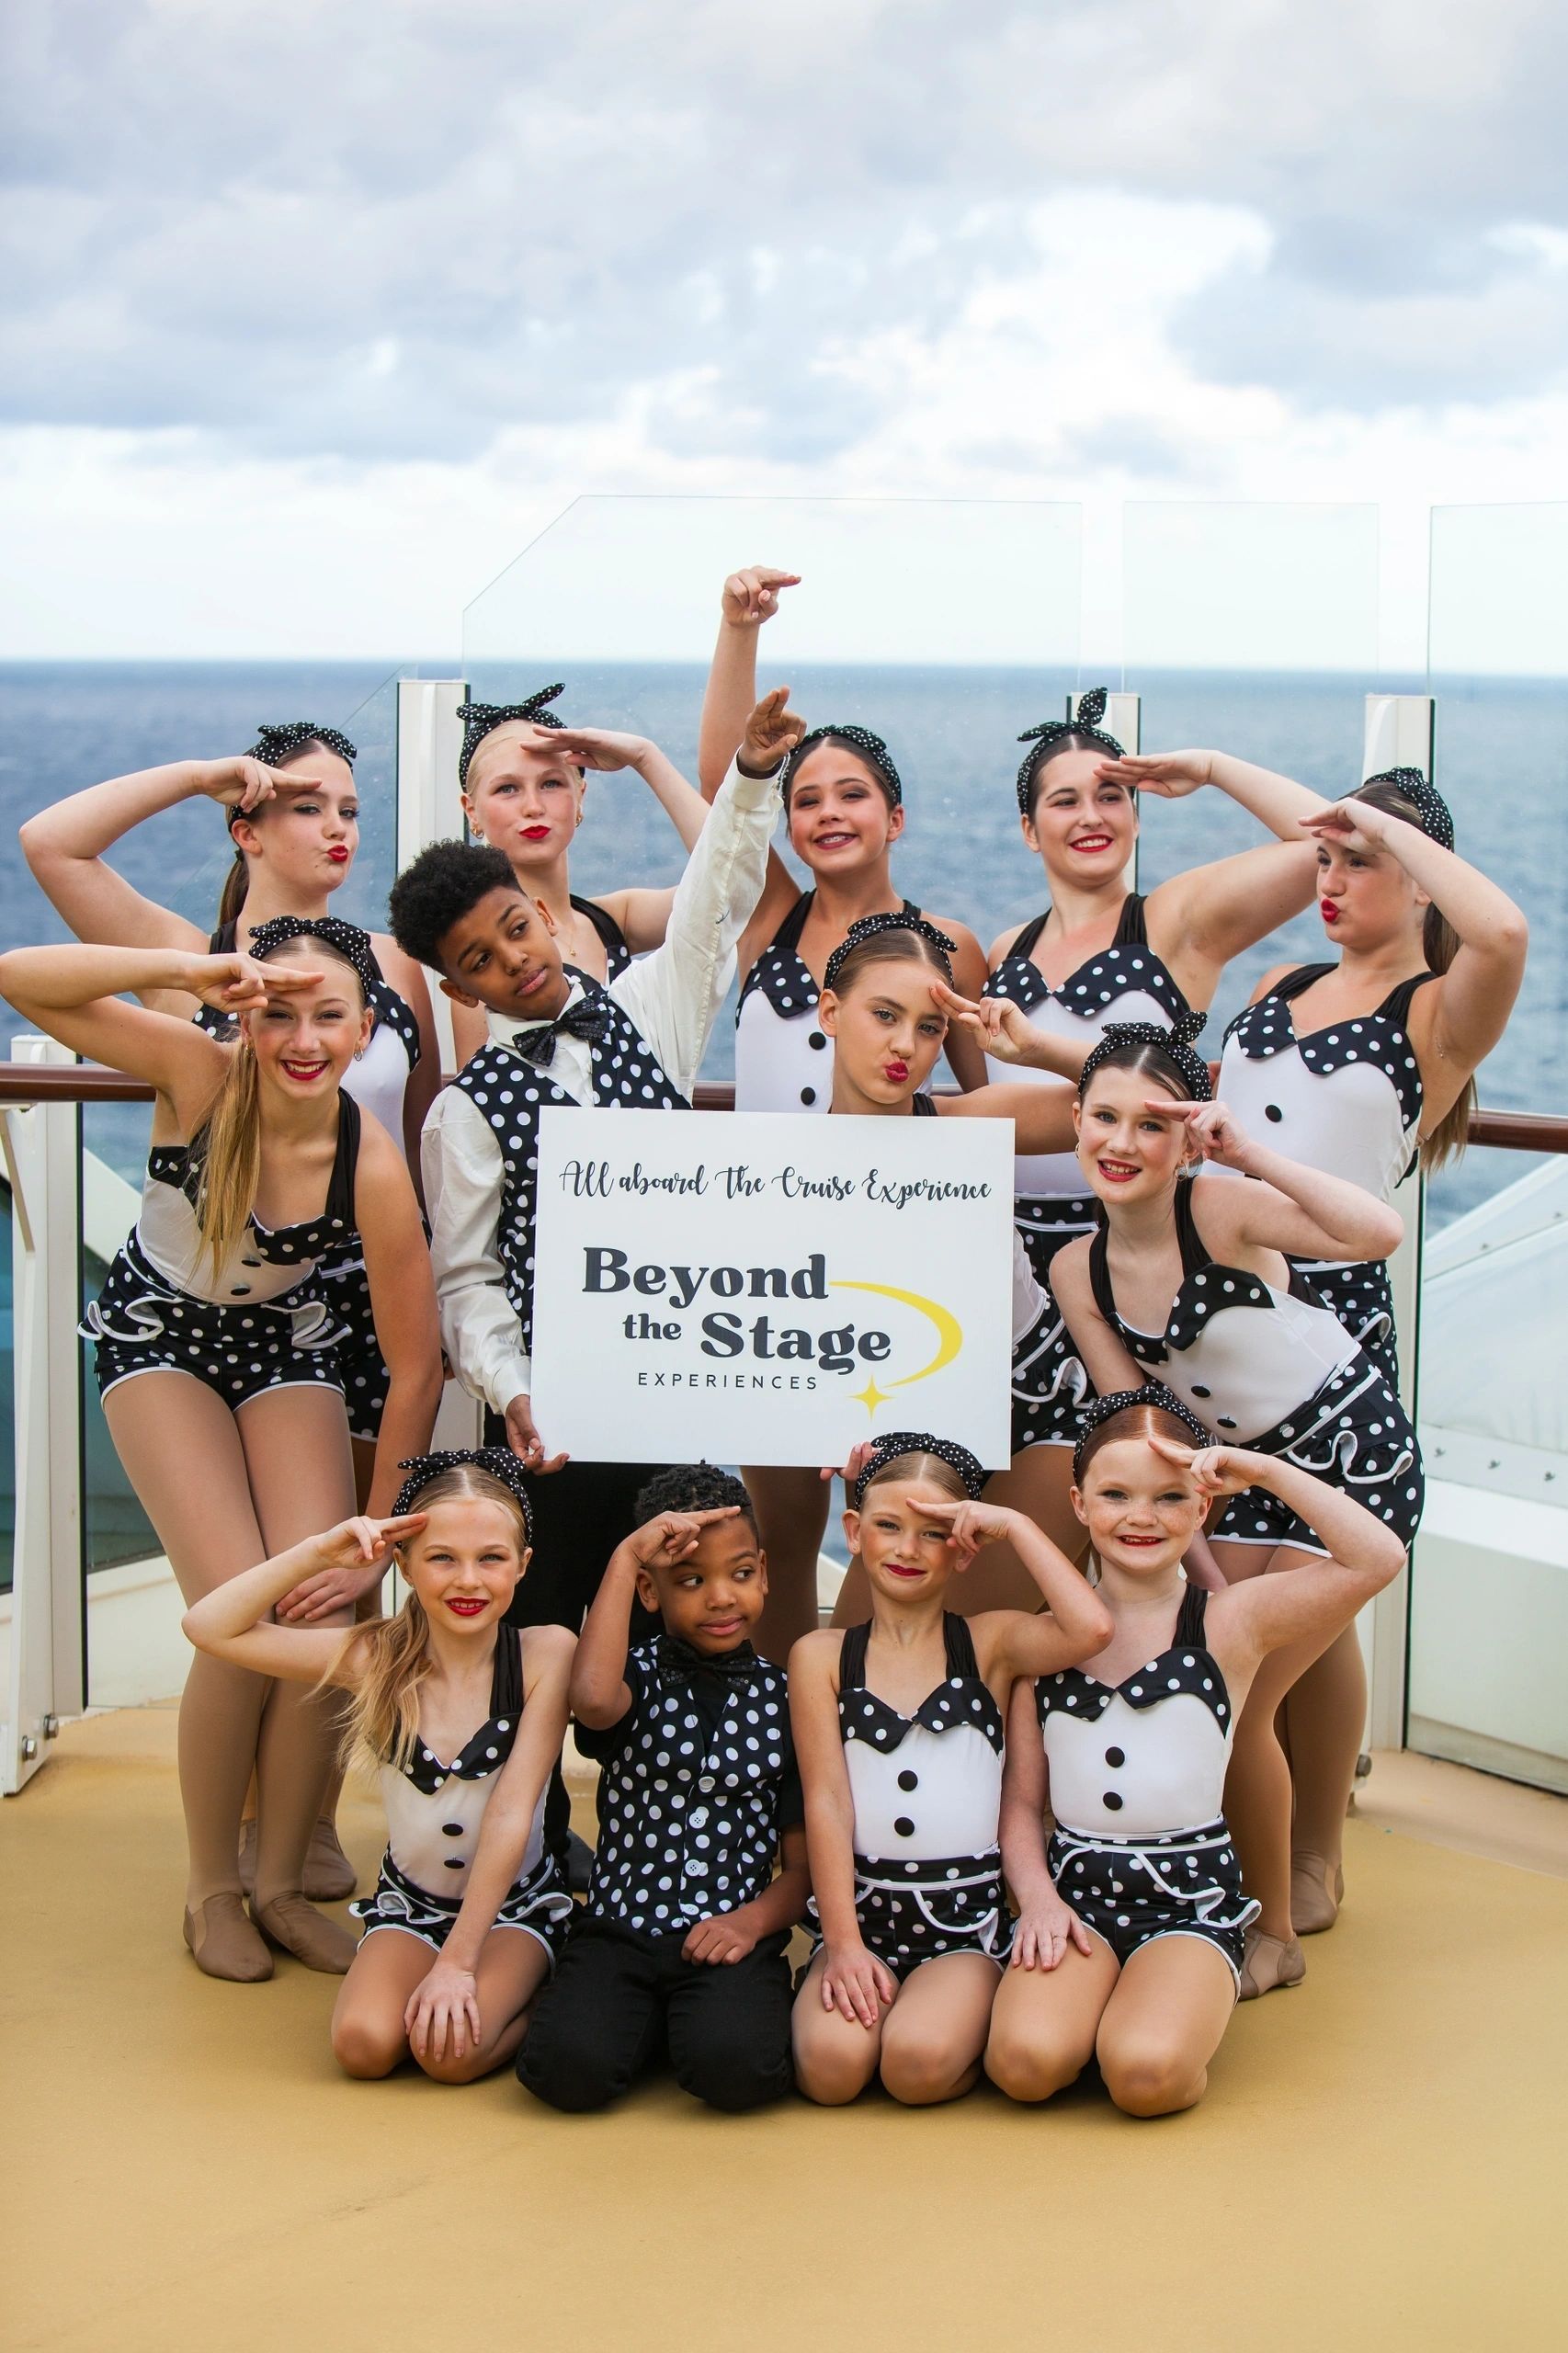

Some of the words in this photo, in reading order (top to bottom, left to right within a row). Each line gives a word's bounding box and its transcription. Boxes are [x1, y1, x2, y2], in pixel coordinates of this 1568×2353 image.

[559, 1160, 615, 1198] All
[619, 1162, 710, 1196] aboard
[770, 1165, 857, 1201] Cruise
[861, 1168, 992, 1211] Experience
[581, 1246, 830, 1310] Beyond
[621, 1313, 682, 1341] the
[699, 1312, 892, 1376] Stage
[638, 1372, 817, 1391] EXPERIENCES
